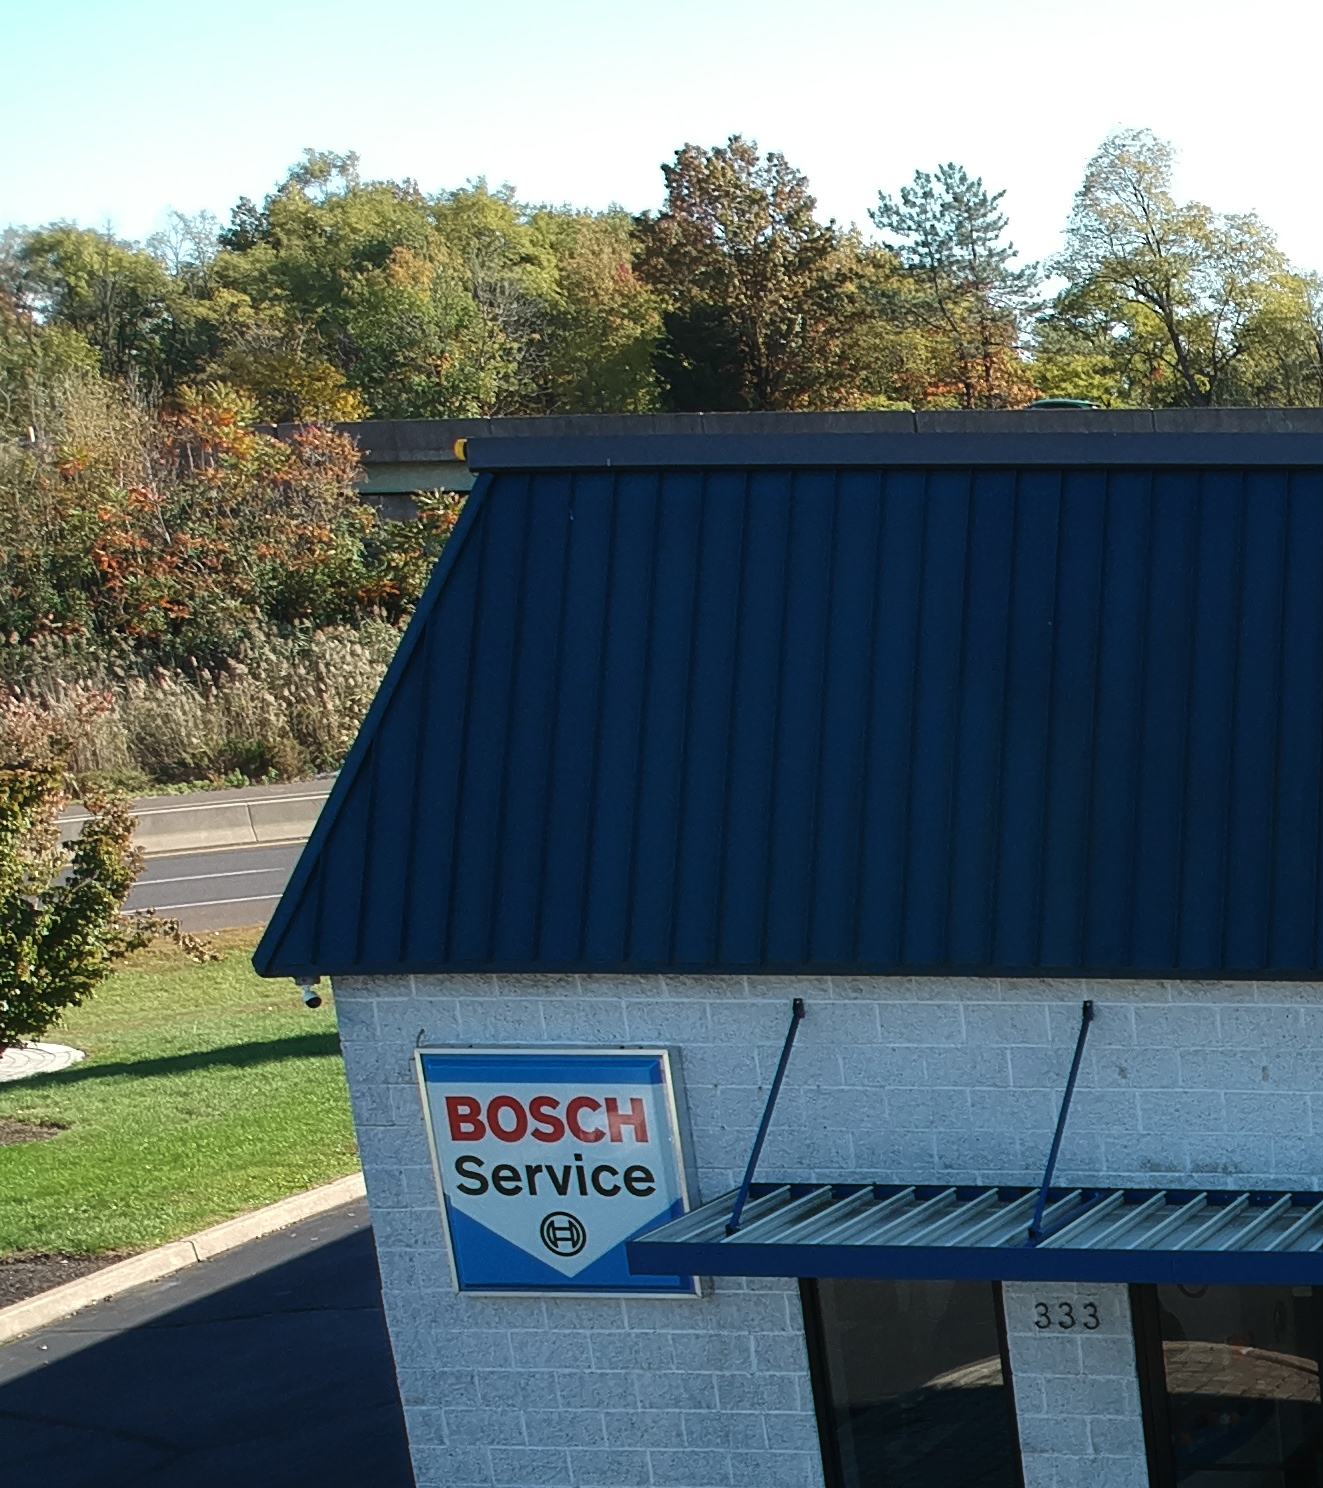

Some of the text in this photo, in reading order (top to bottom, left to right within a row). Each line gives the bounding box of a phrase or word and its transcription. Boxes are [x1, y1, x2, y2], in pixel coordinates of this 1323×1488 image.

[444, 1095, 649, 1143] BOSCH
[454, 1153, 657, 1197] Service
[1034, 1301, 1100, 1330] 333
